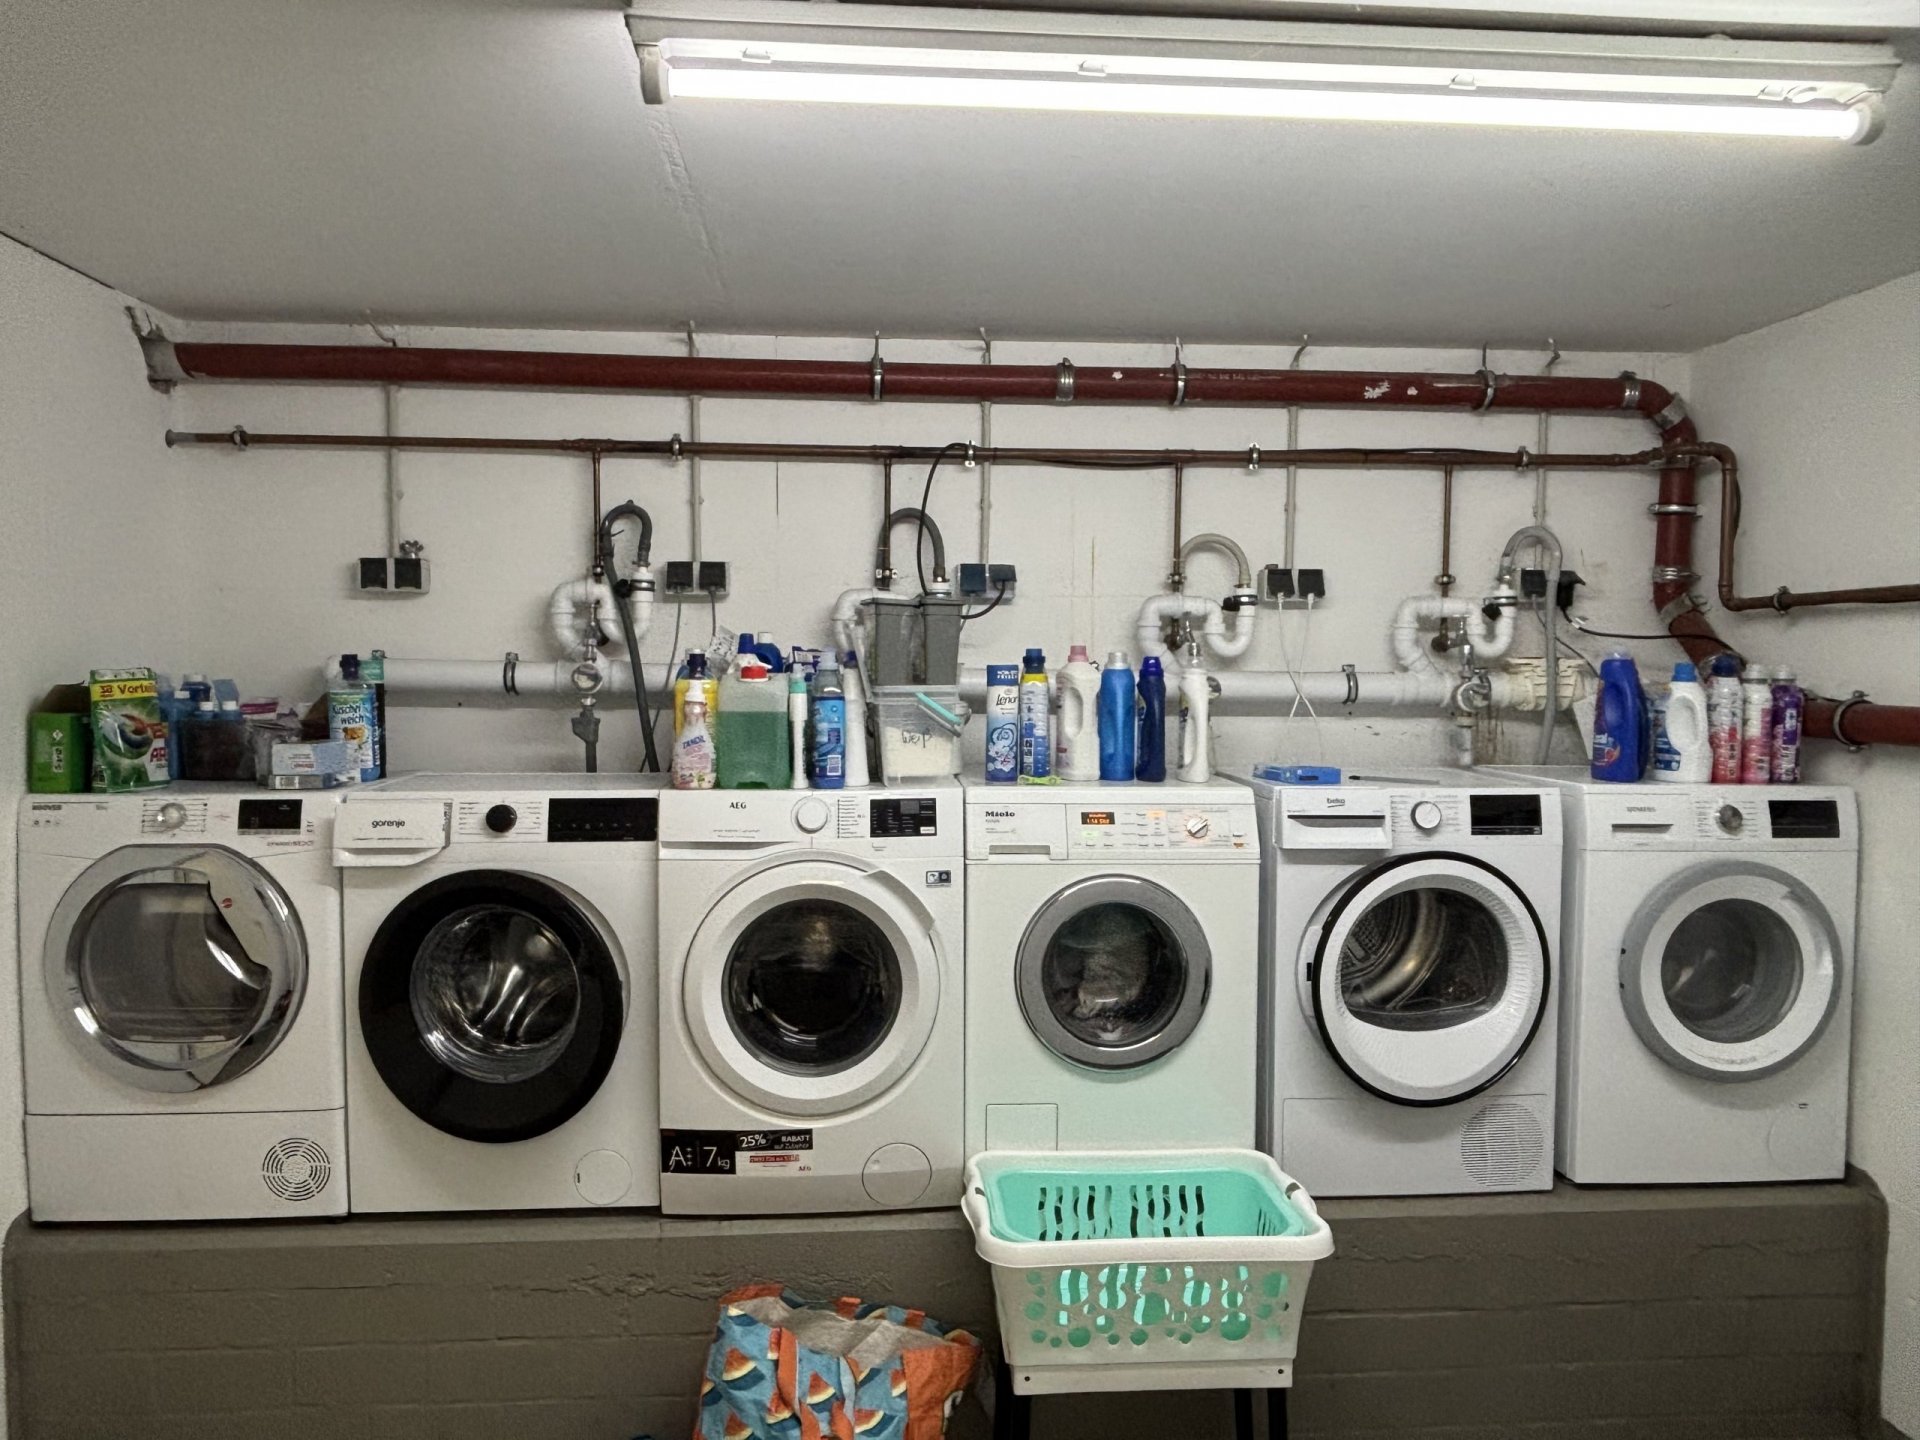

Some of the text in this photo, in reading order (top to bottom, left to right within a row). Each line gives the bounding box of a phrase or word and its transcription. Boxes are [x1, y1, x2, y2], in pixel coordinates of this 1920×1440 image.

[729, 801, 747, 809] AEG
[371, 820, 406, 829] gorenje
[740, 1134, 766, 1147] 25%
